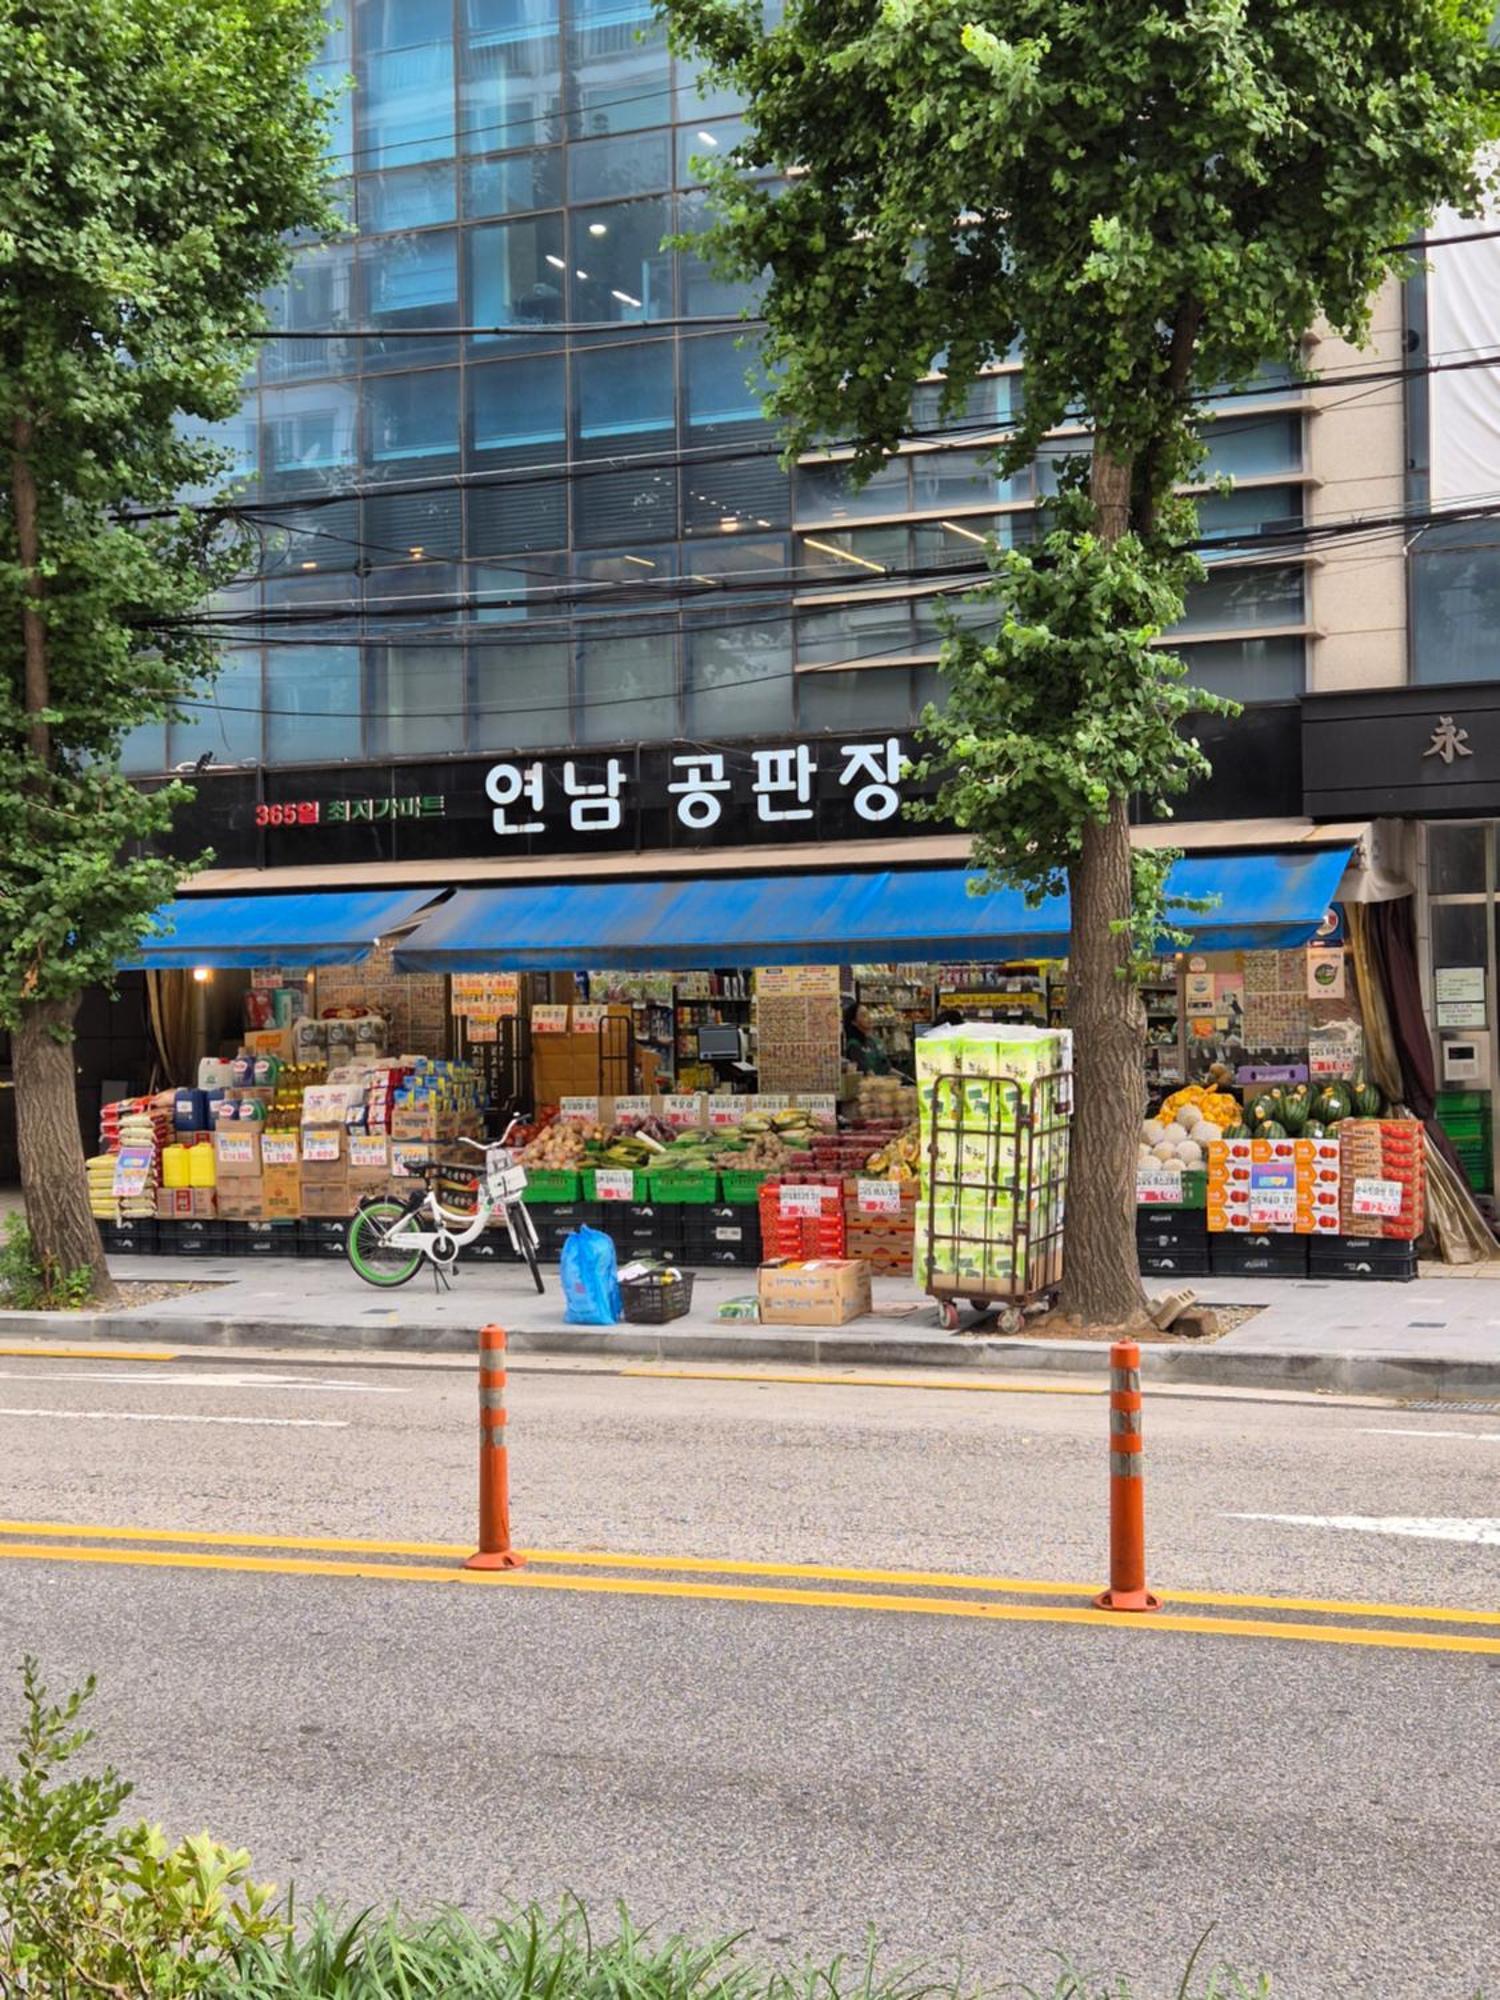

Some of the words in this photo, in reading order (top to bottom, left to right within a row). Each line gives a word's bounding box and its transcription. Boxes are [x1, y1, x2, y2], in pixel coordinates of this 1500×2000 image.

[1423, 716, 1473, 764] 永
[485, 758, 627, 835] 연남
[668, 738, 908, 828] 공판장
[256, 800, 320, 826] 365일
